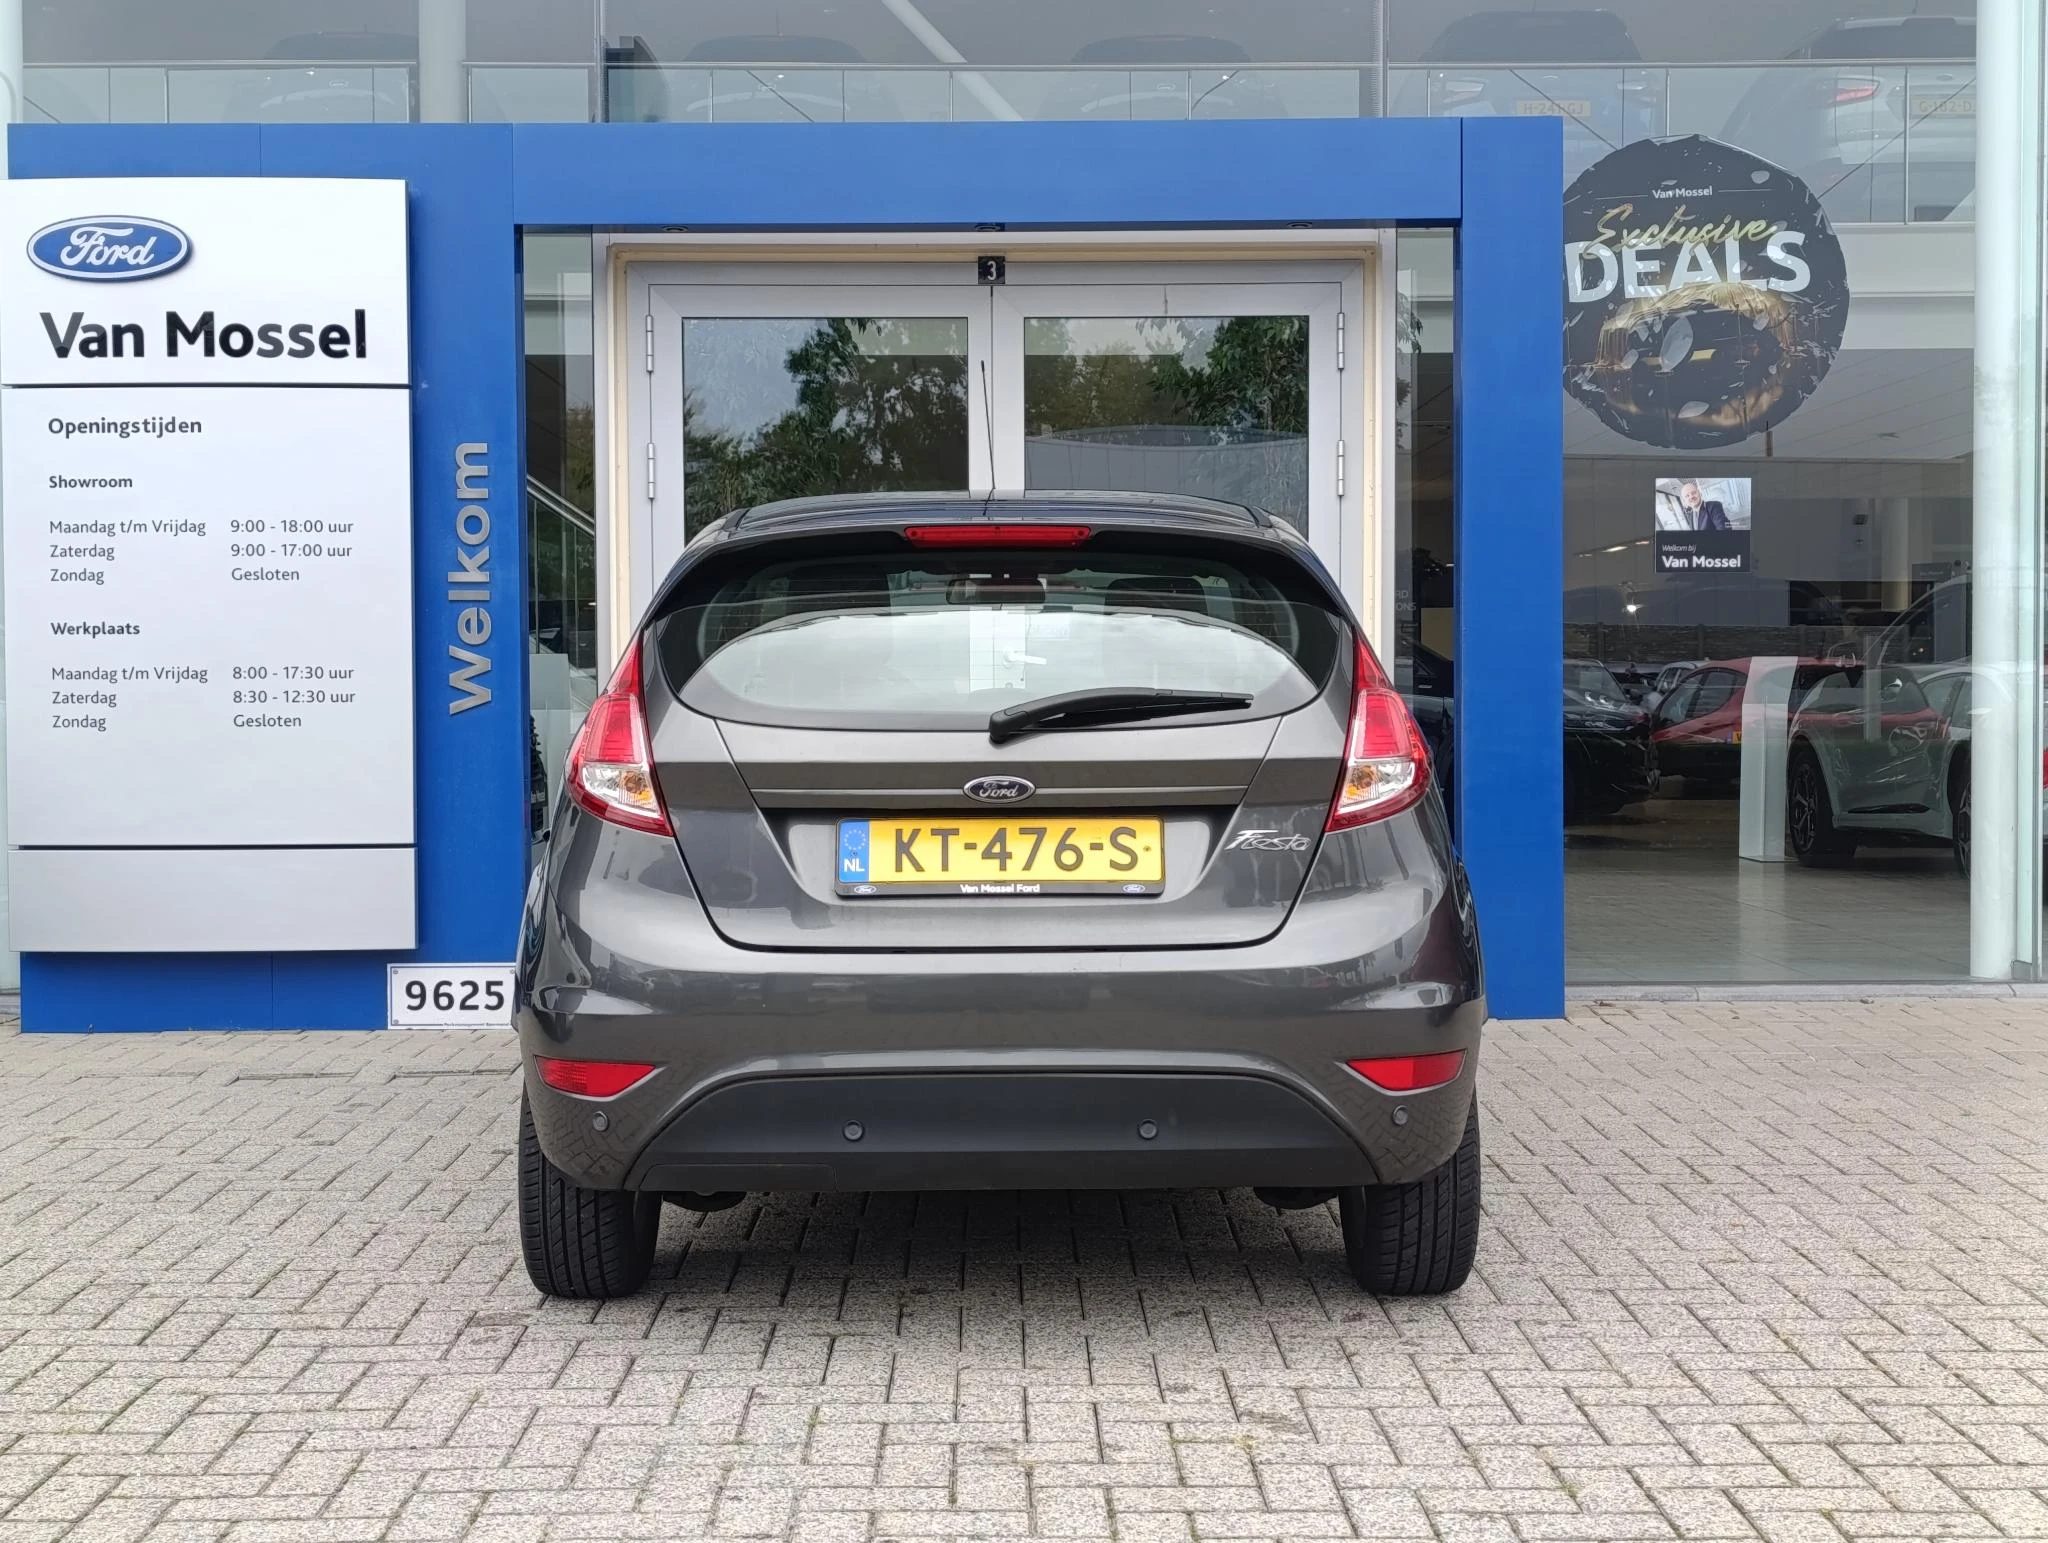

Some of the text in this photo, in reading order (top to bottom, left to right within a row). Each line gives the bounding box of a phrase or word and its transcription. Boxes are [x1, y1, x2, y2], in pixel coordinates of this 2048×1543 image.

[1524, 102, 1584, 115] H-241GJ
[1652, 186, 1713, 199] Van Mossel
[1582, 203, 1778, 259] Exclusive
[60, 226, 158, 266] Ford
[987, 260, 997, 281] 3
[1564, 230, 1811, 302] DEALS
[39, 308, 367, 359] Van Mossel
[47, 415, 202, 440] Openingstijden
[48, 474, 133, 489] Showroom
[49, 518, 207, 538] Maandag t/m Vrijdag
[230, 519, 266, 533] 9:00
[280, 519, 324, 533] 18:00
[328, 521, 354, 533] uur
[49, 543, 115, 562] Zaterdag
[230, 543, 266, 557] 9:00
[280, 543, 323, 557] 17:00
[327, 545, 353, 557] uur
[1661, 544, 1697, 553] Welkom bij
[1661, 554, 1741, 568] Van Mossel
[50, 567, 105, 586] Zondag
[231, 566, 300, 581] Gesloten
[447, 441, 492, 716] Welkom
[49, 620, 141, 640] Werkplaats
[51, 665, 209, 685] Maandag t/m Vrijdag
[232, 666, 268, 680] 8:00
[282, 665, 324, 680] 17:30
[328, 669, 355, 680] uur
[51, 689, 117, 709] Zaterdag
[232, 690, 268, 704] 8:30
[282, 689, 326, 704] 12:30
[330, 692, 357, 703] uur
[51, 714, 107, 733] Zondag
[233, 713, 302, 728] Gesloten
[979, 779, 1019, 799] Ford
[894, 826, 1139, 873] KT-476-S
[1224, 829, 1313, 851] Fiesta
[843, 858, 865, 873] NL
[960, 883, 1041, 894] Van Mossel Ford
[405, 980, 505, 1012] 9625
